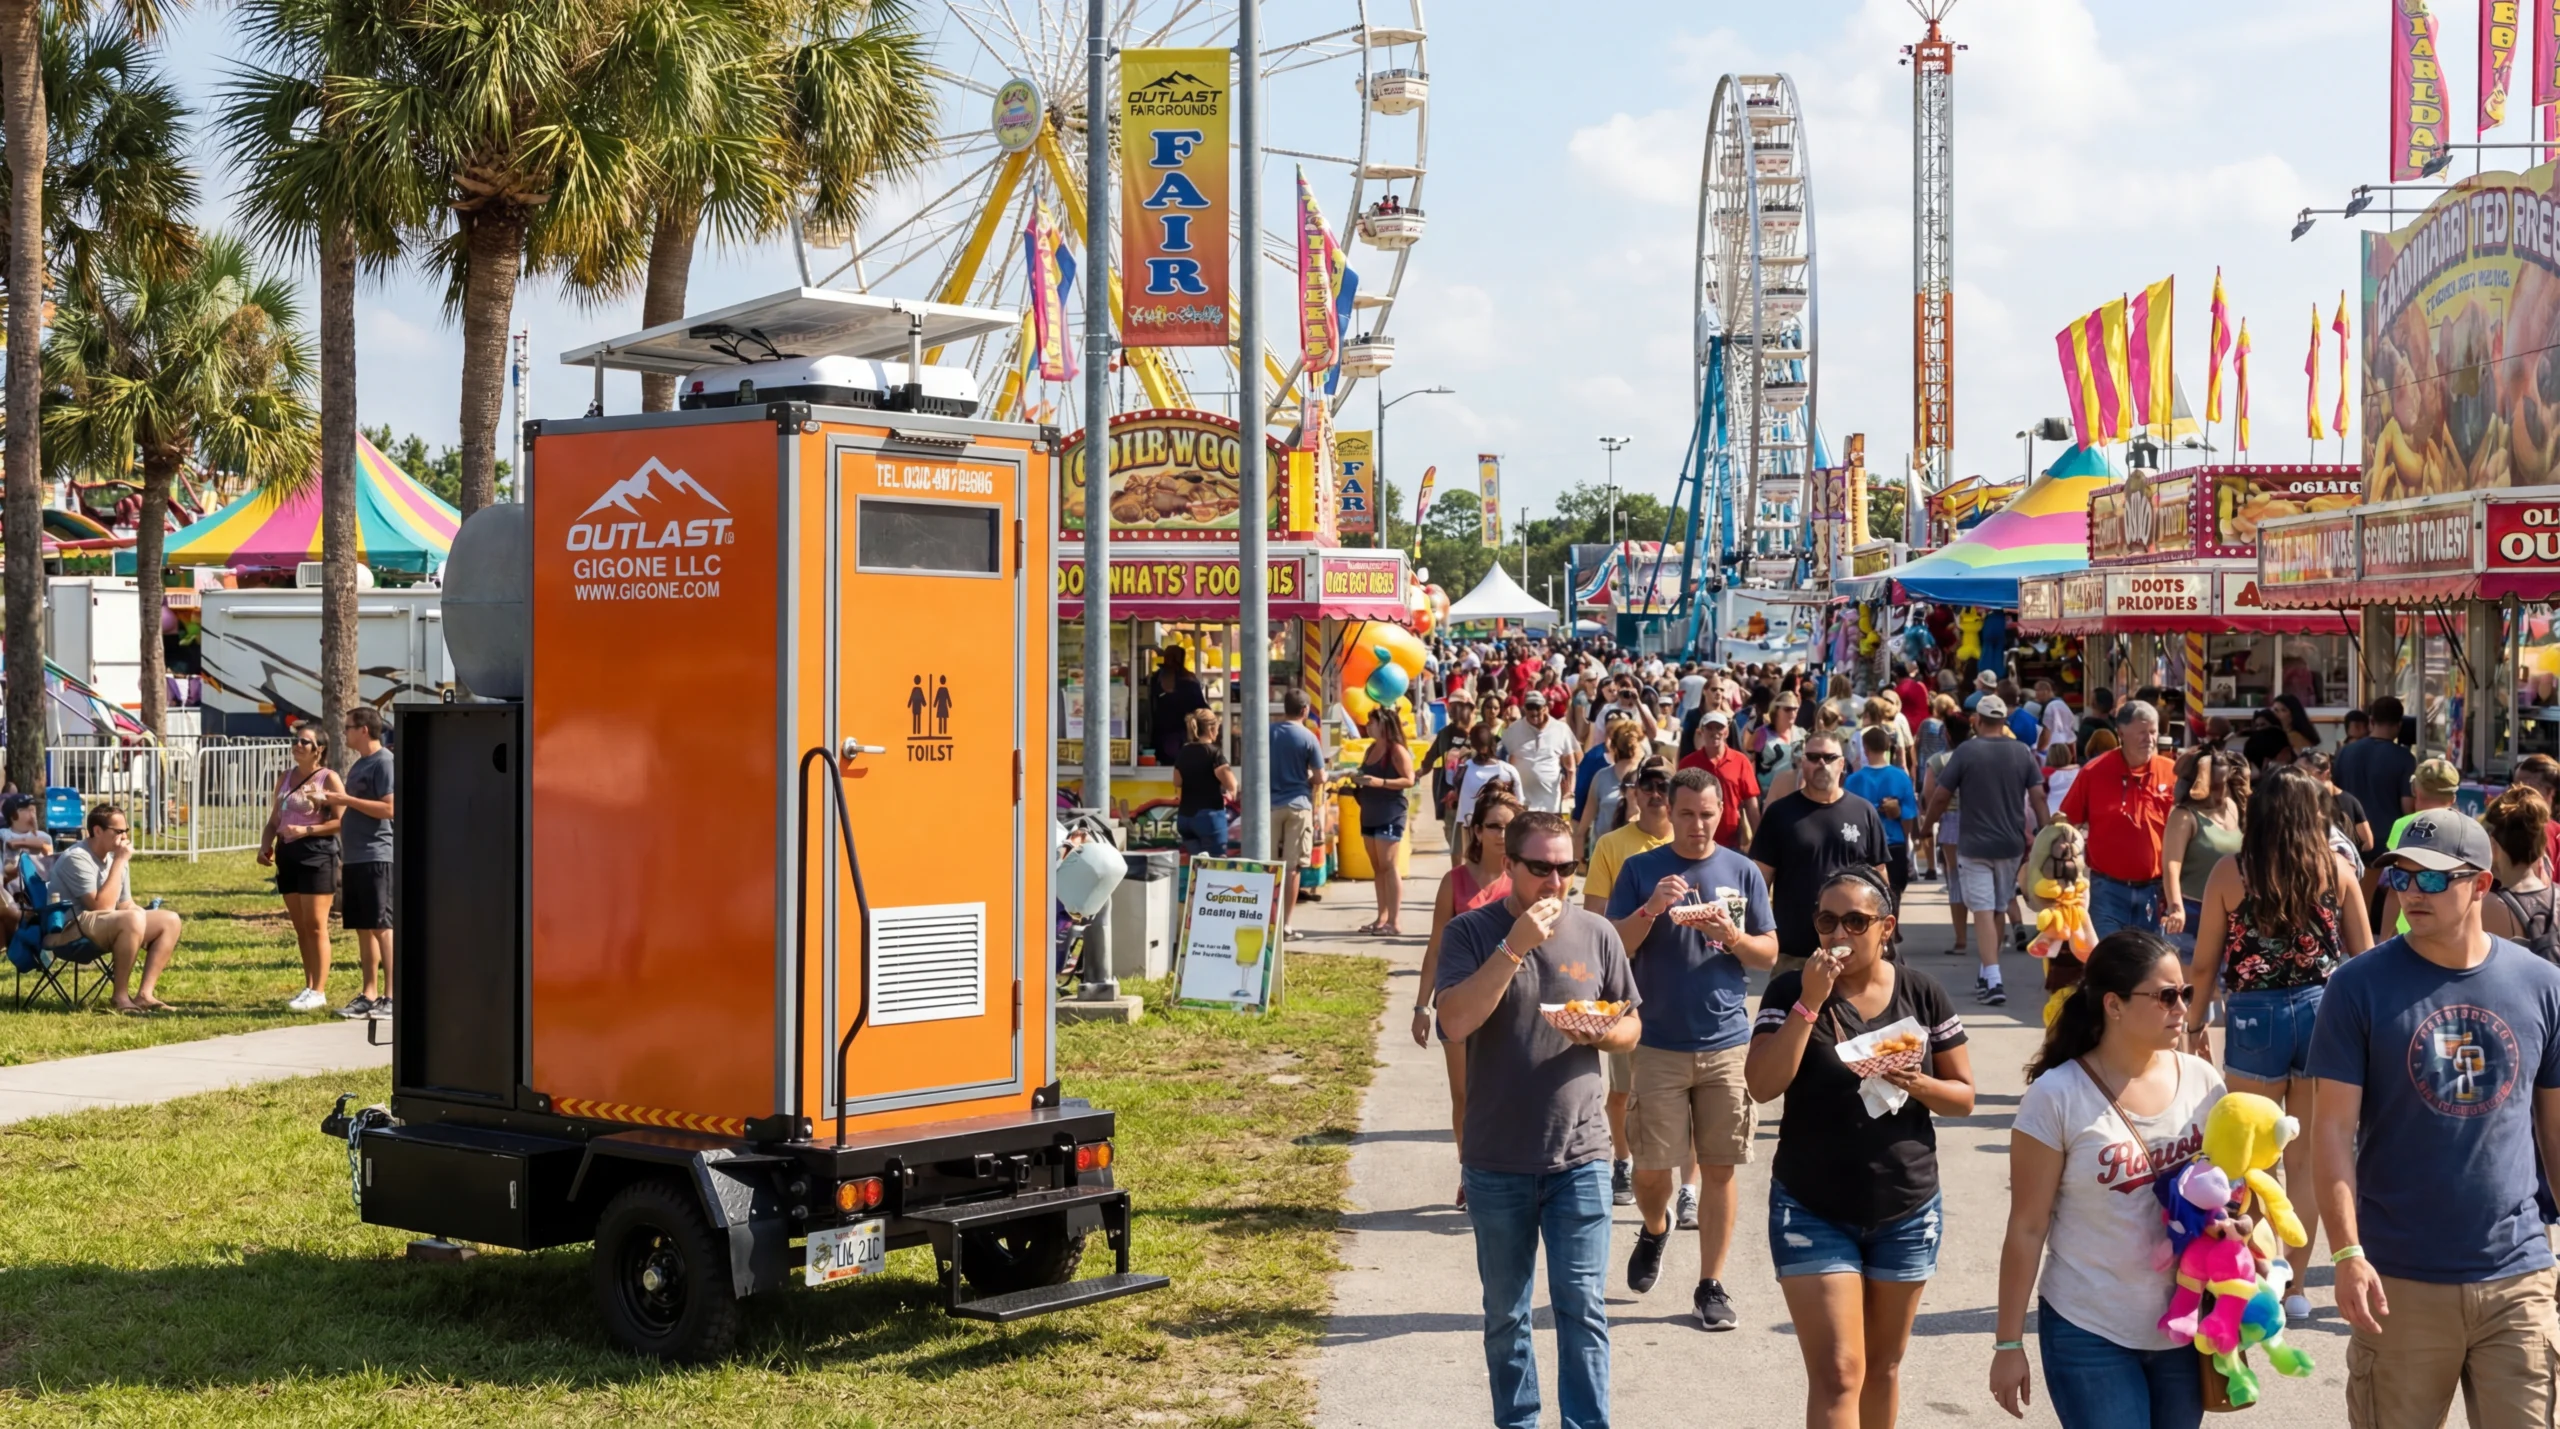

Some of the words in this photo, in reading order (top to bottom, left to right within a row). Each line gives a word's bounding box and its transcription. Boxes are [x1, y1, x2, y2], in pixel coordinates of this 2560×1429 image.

[1127, 90, 1222, 103] OUTLAST
[1130, 104, 1217, 116] FAIRGROUNDS
[1142, 128, 1211, 295] FAIR
[2471, 192, 2508, 246] TED
[566, 518, 733, 551] OUTLAST
[573, 557, 667, 579] GIGONE
[675, 555, 721, 577] LLC
[574, 581, 720, 601] WWW.GIGONE.COM
[2131, 579, 2185, 593] DOOTS
[906, 744, 954, 762] TOILST
